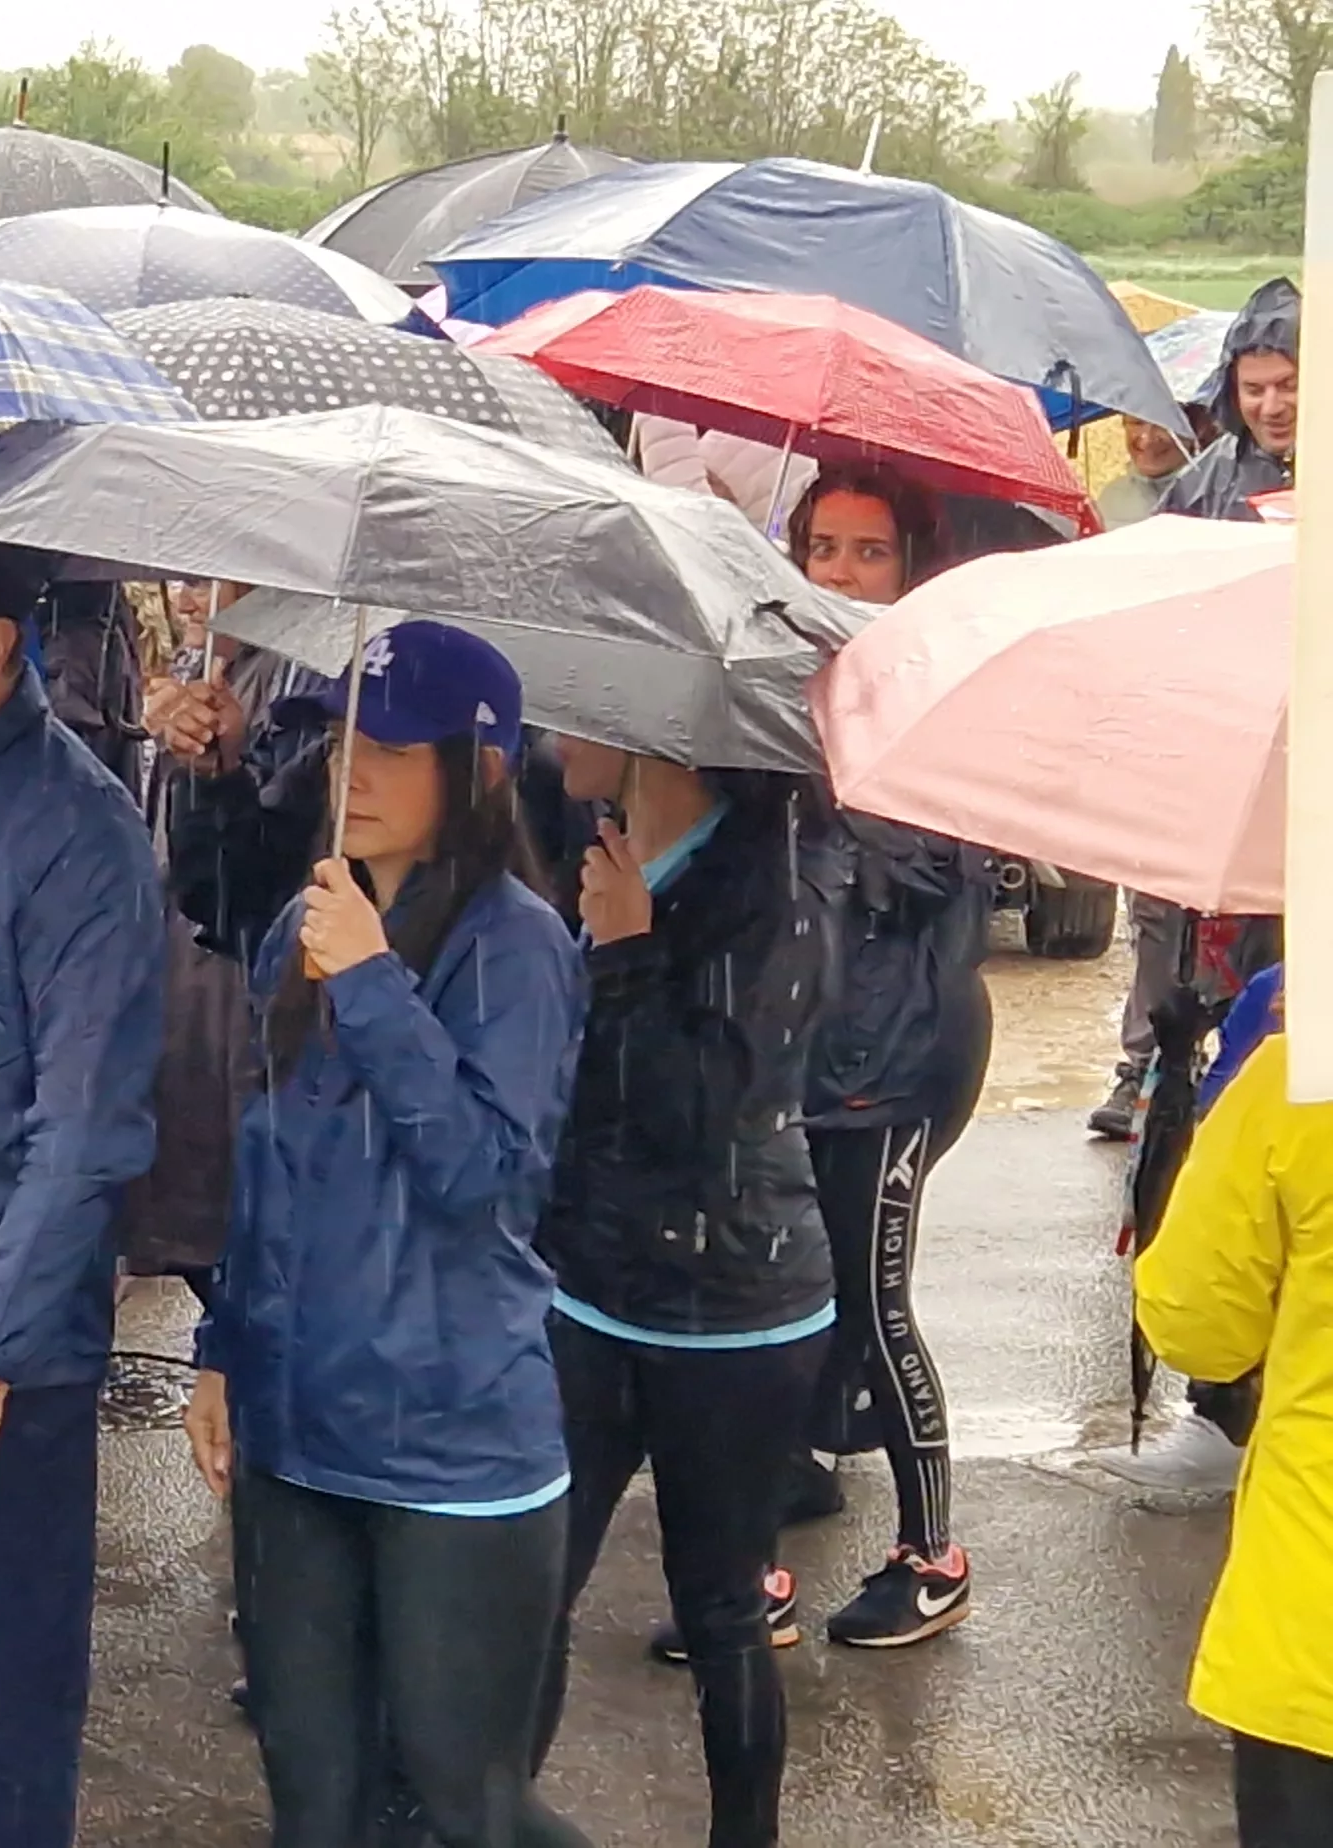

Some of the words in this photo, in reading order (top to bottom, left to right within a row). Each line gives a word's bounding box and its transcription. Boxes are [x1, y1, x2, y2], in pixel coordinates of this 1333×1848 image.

[882, 1215, 905, 1289] HIGH
[886, 1309, 909, 1338] UP
[900, 1353, 941, 1436] STAND
